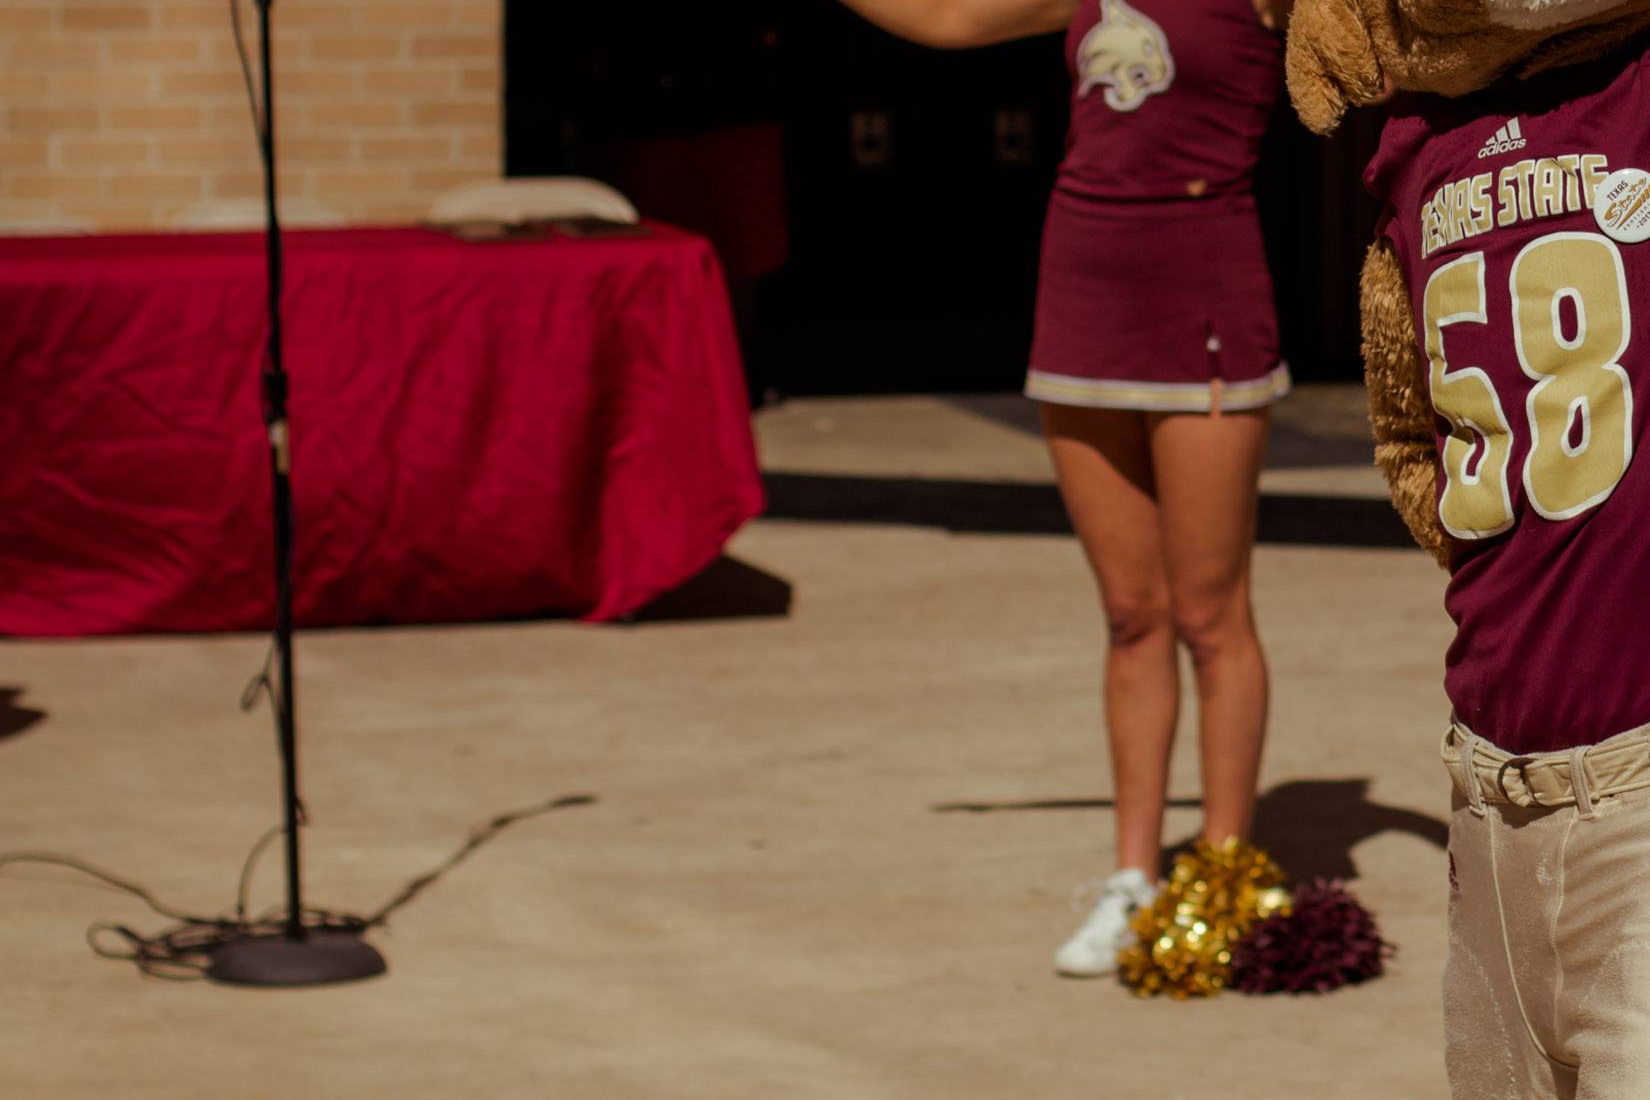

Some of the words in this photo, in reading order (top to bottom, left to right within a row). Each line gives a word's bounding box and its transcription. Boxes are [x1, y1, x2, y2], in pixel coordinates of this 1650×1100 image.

[1478, 139, 1527, 159] adidas
[1421, 171, 1494, 260] TEXAS
[1497, 154, 1609, 228] STATE
[1606, 180, 1629, 202] TEXAS
[1423, 231, 1632, 540] 68
